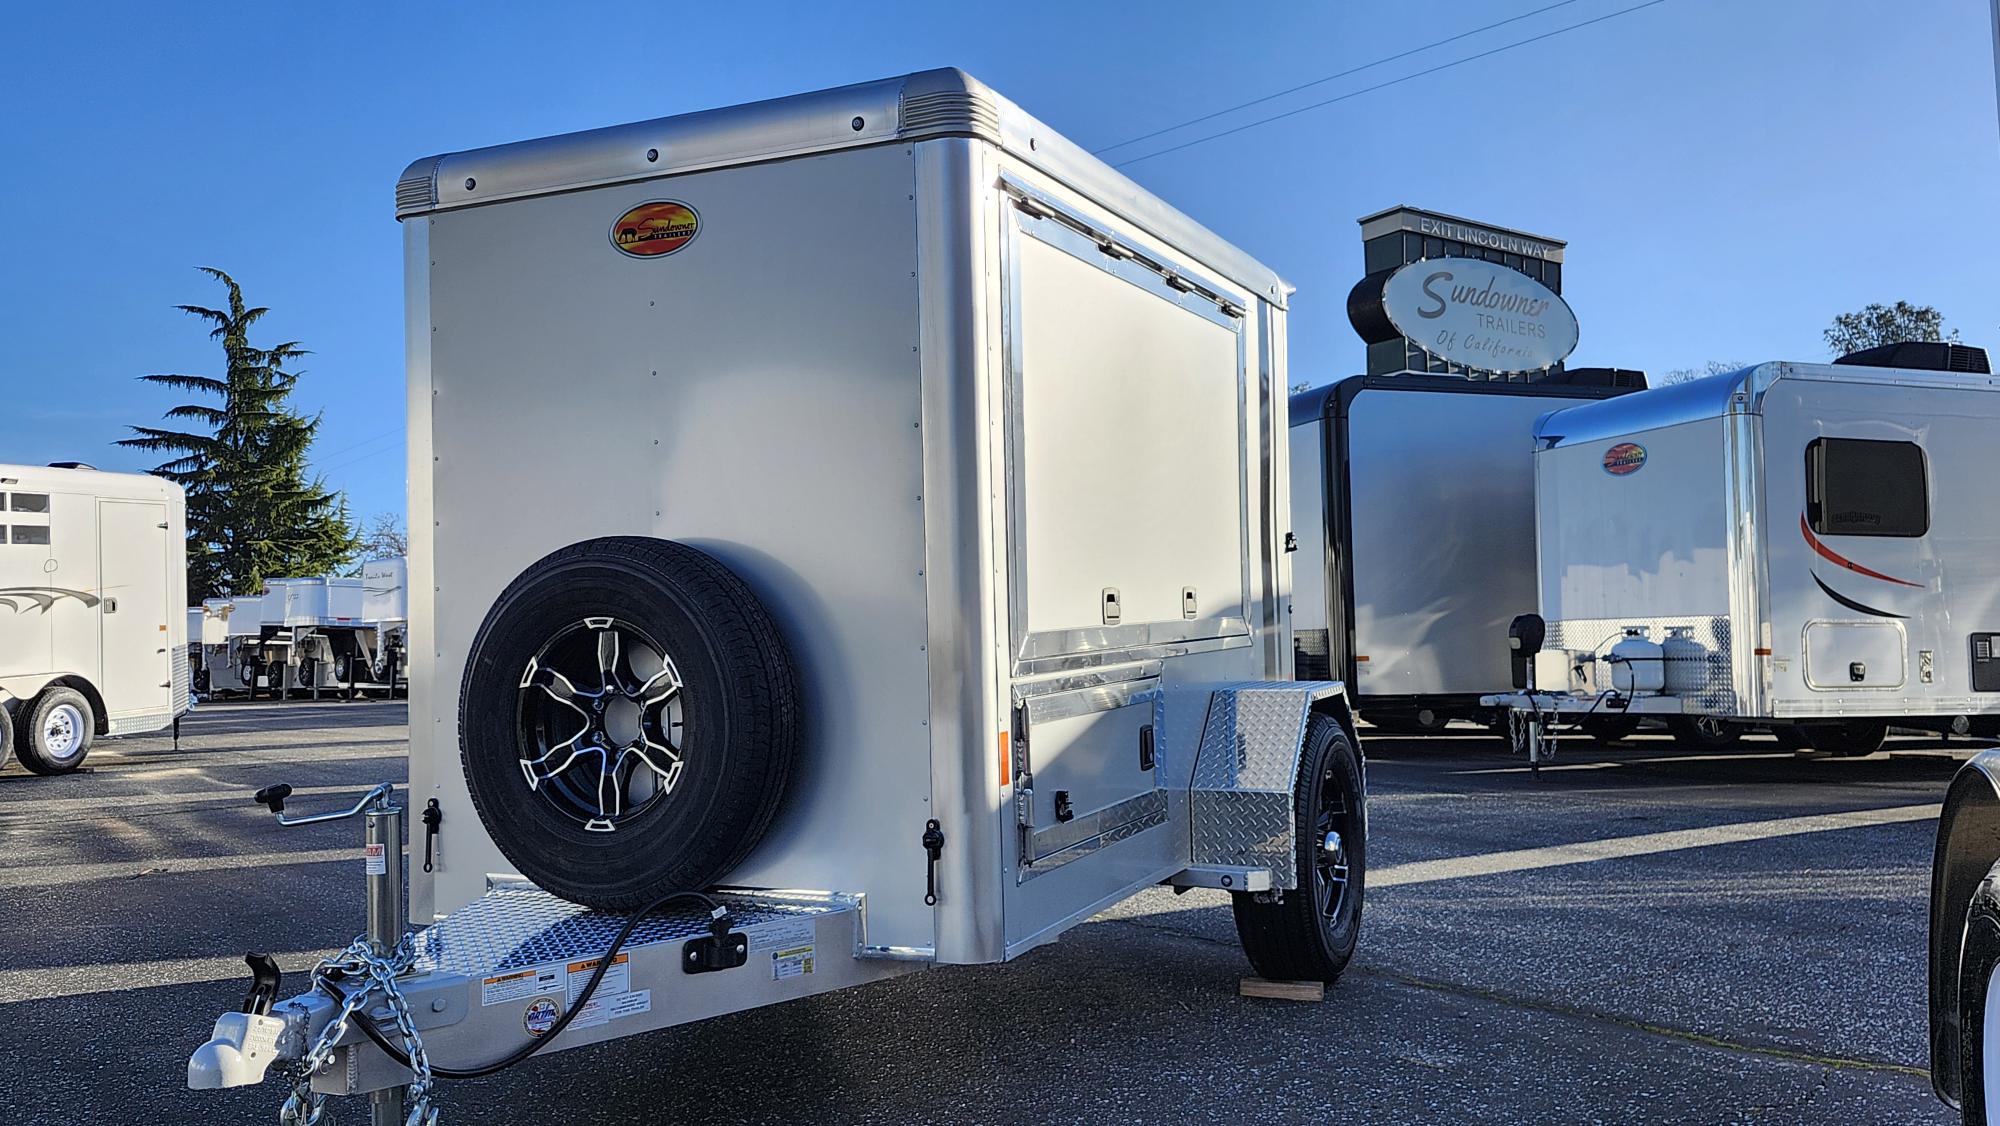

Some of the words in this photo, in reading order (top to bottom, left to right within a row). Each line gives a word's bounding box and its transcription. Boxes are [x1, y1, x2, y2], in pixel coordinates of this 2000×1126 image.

[637, 217, 695, 234] Sundowner
[1420, 217, 1453, 238] EXIT
[1456, 226, 1518, 252] LINCOLN
[1520, 240, 1549, 258] WAY
[1416, 271, 1549, 319] Sundowner
[1476, 313, 1546, 339] TRAILERS
[1436, 329, 1456, 351] Of
[1463, 334, 1534, 358] California
